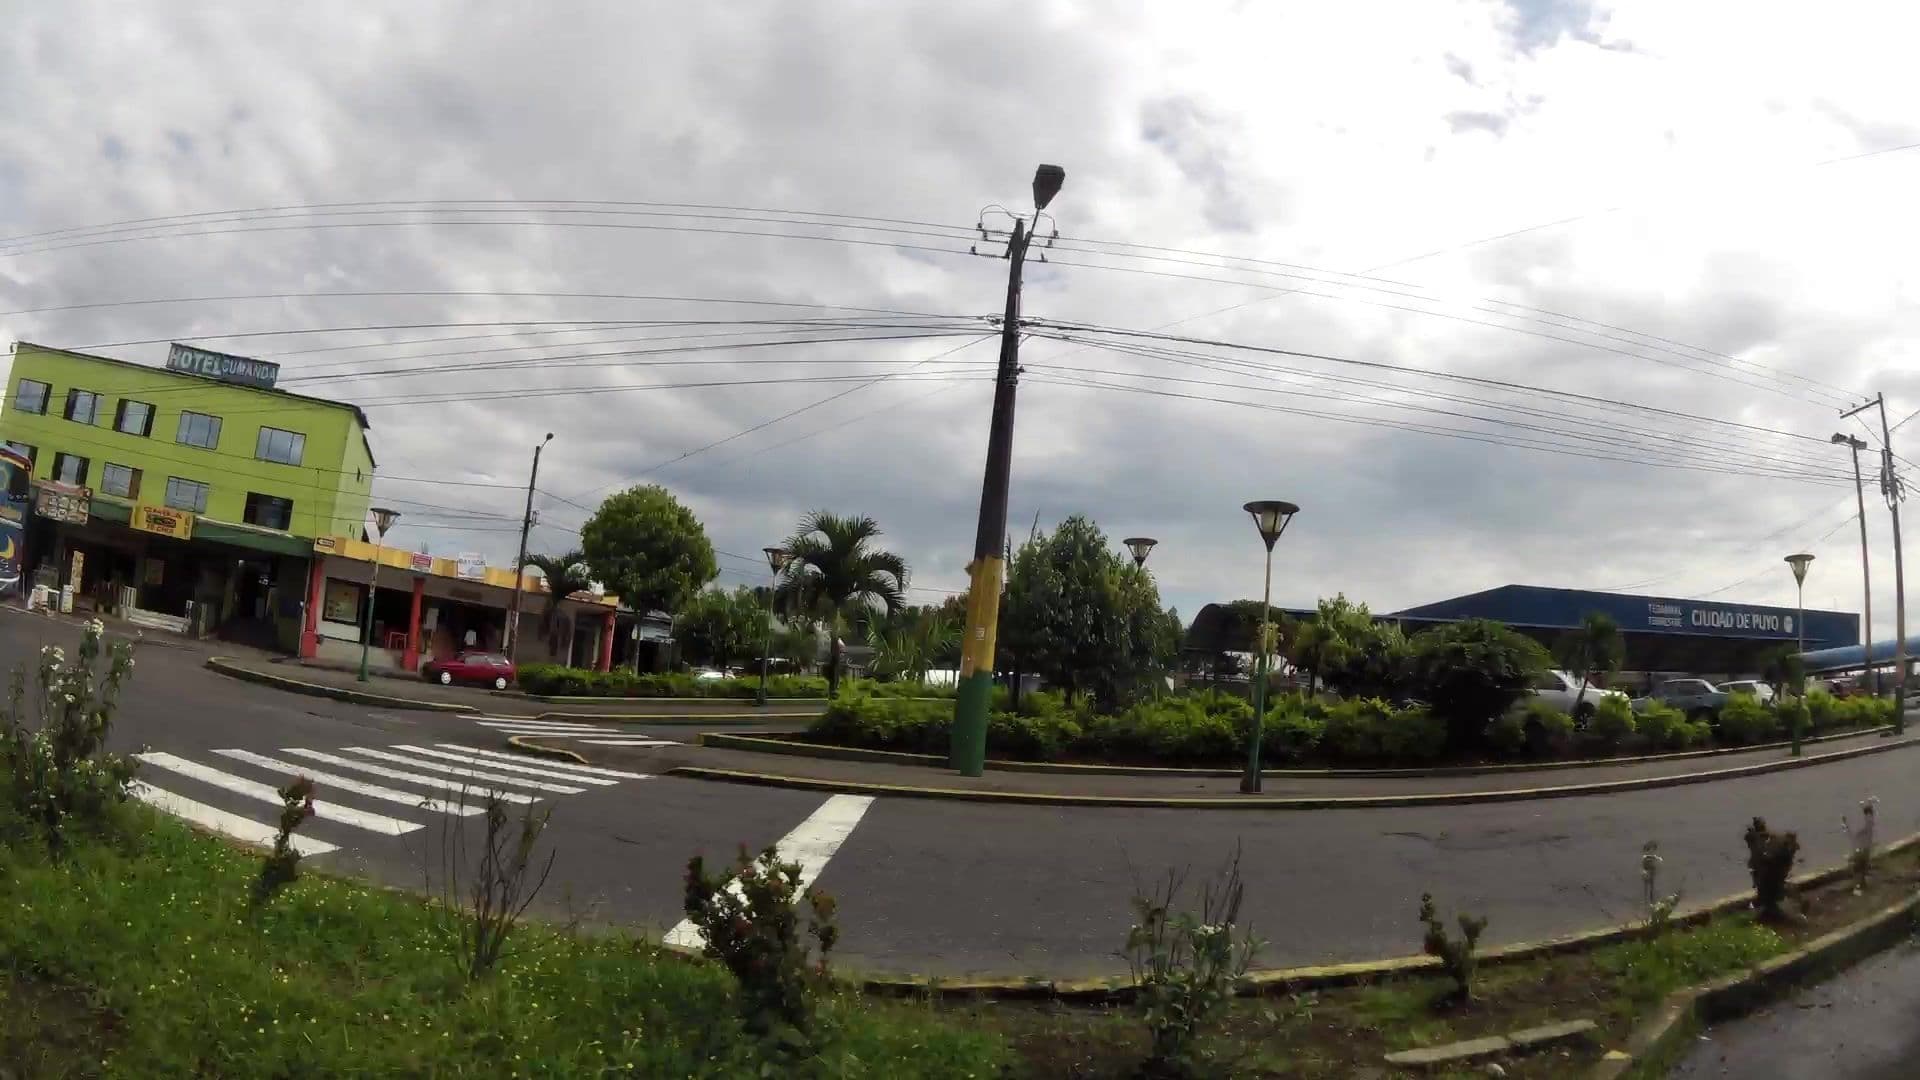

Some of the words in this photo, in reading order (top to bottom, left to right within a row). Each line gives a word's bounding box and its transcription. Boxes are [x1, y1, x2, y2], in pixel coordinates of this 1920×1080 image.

[168, 344, 221, 376] HOTEL
[1691, 609, 1734, 628] CIUDAD
[1736, 612, 1750, 629] DE
[1752, 613, 1779, 631] PUYO
